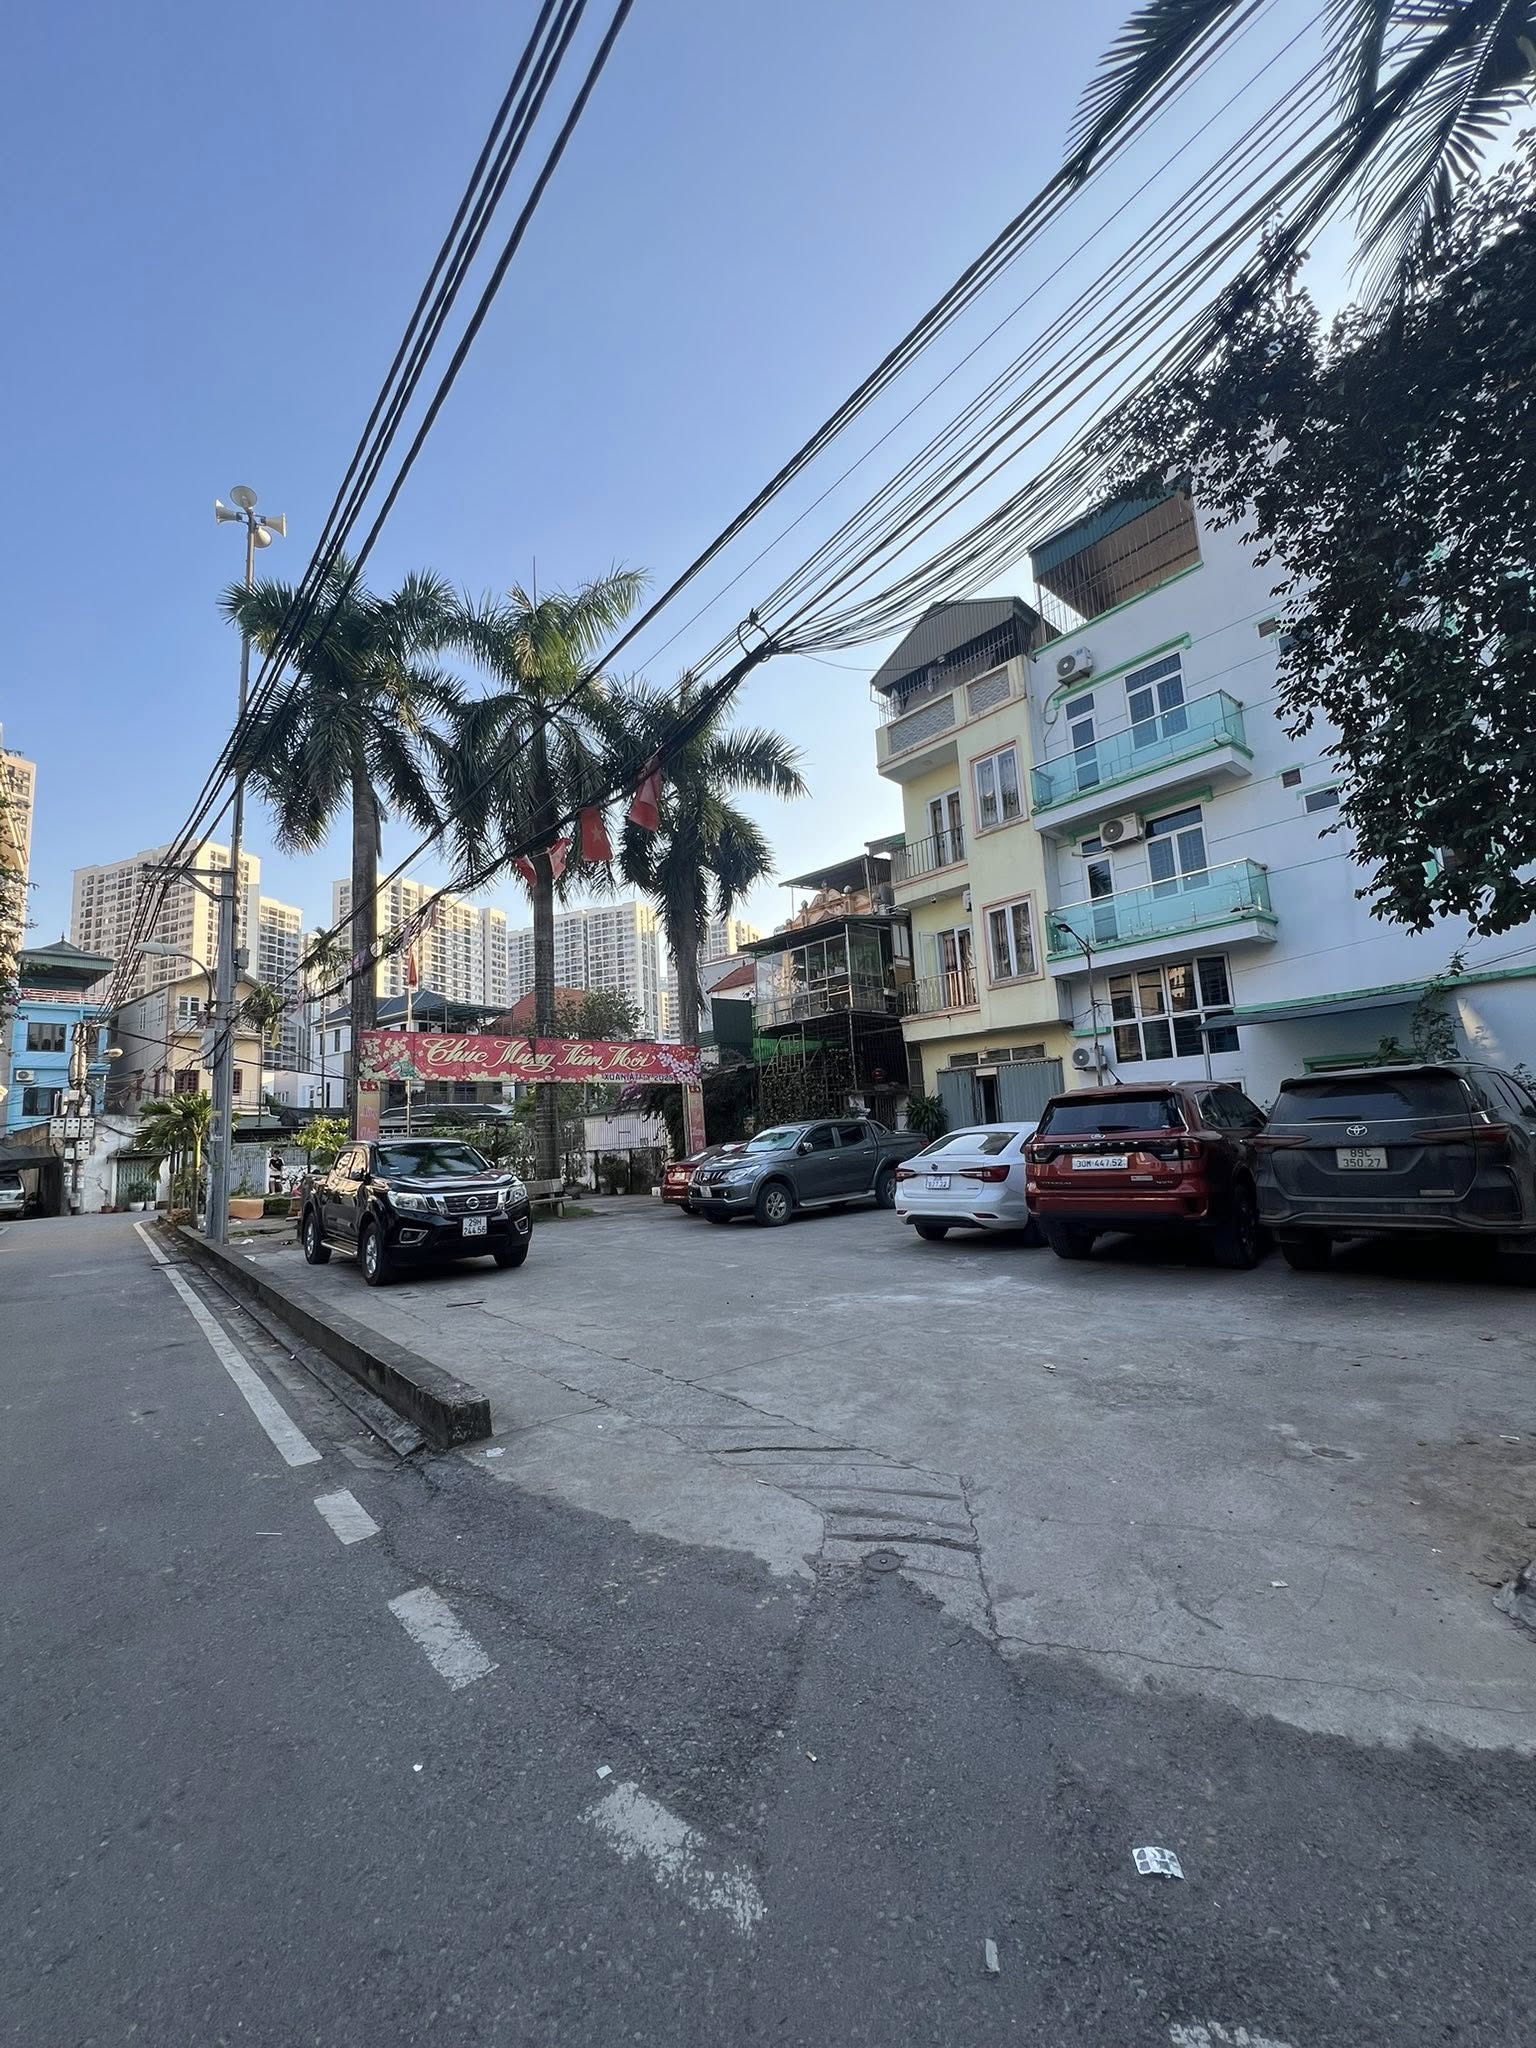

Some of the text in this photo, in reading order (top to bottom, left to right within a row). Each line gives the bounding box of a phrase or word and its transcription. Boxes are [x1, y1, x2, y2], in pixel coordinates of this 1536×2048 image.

[422, 1038, 489, 1067] Chúc
[557, 1044, 604, 1067] Năm
[599, 1046, 657, 1071] Mới
[654, 1073, 674, 1082] 2025
[1350, 1148, 1371, 1158] 89C
